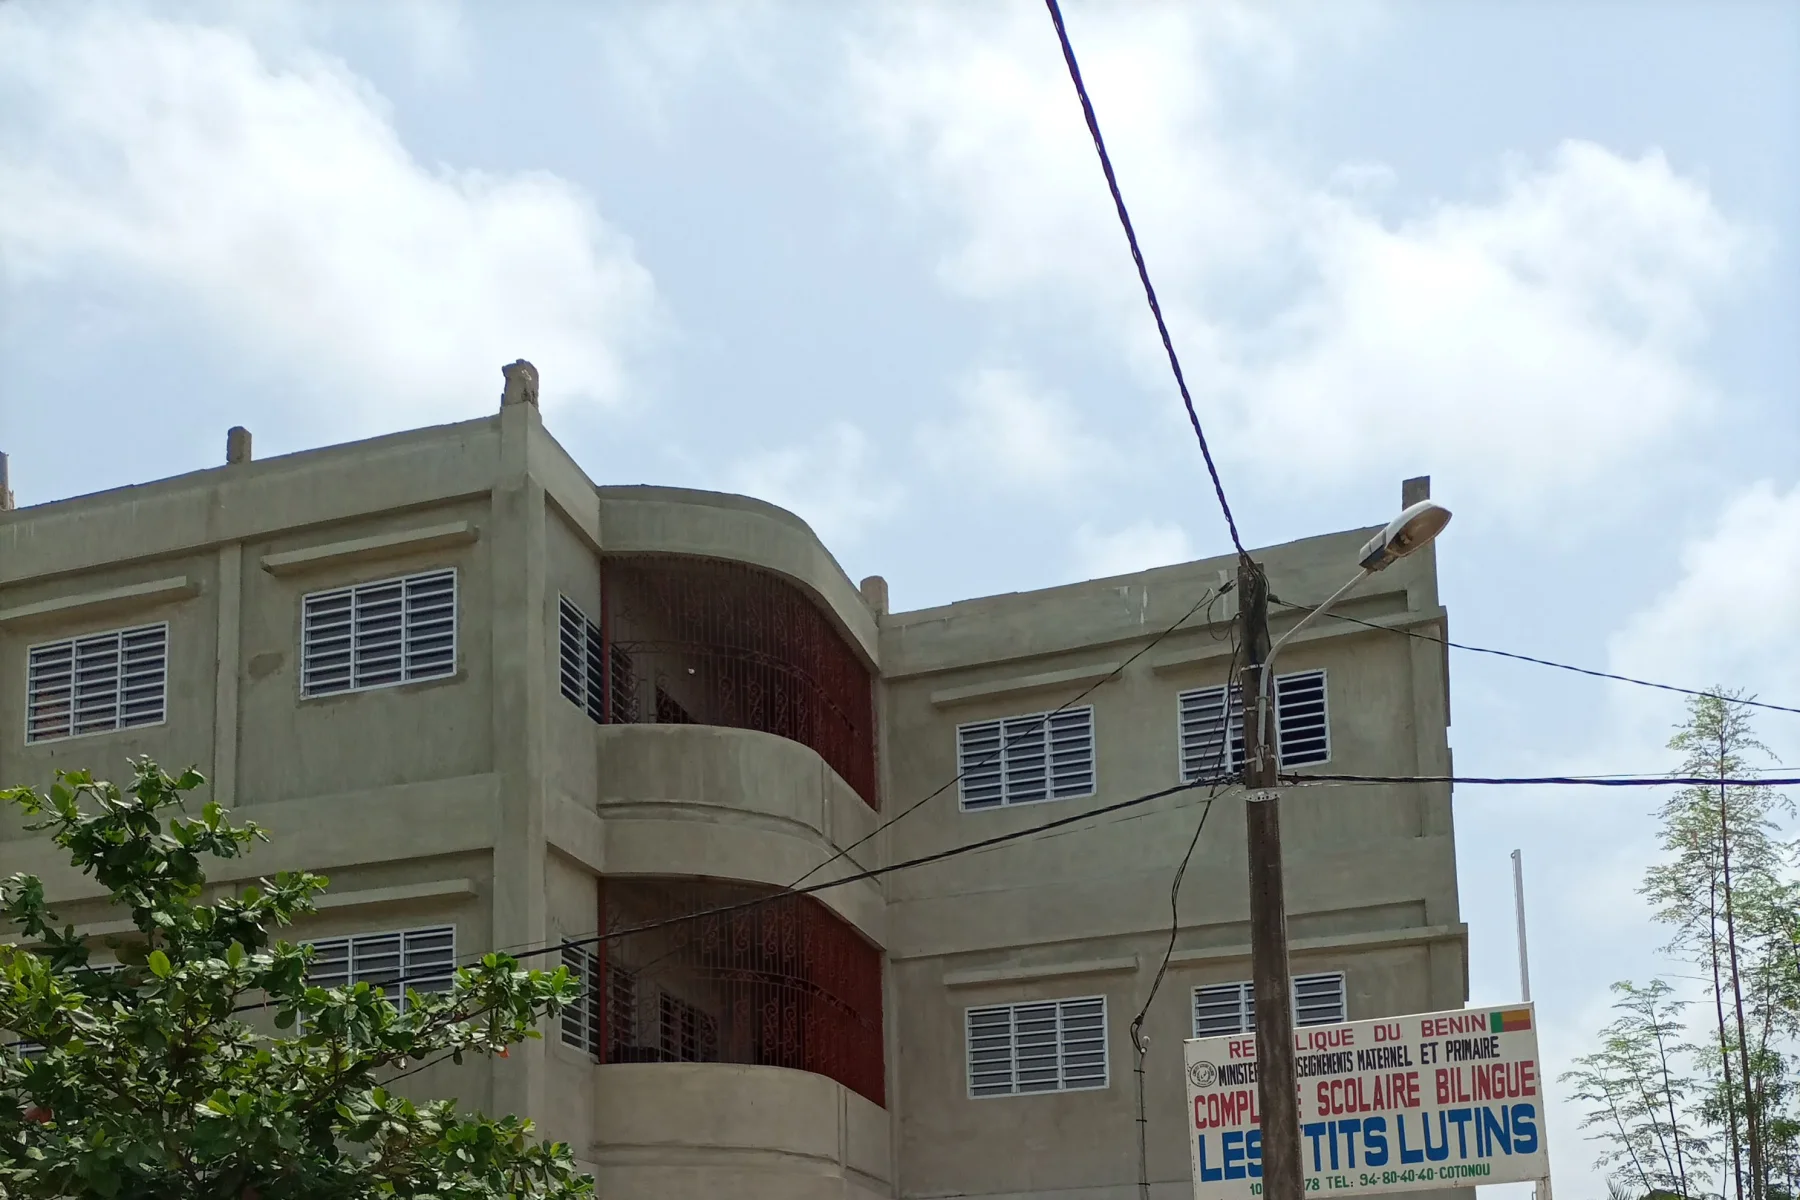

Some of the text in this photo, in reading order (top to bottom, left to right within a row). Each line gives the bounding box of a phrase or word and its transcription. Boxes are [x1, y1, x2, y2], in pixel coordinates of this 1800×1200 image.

[1229, 1013, 1486, 1058] RELIQUE DU BENIN
[1357, 1045, 1413, 1071] MATERNEL
[1420, 1041, 1439, 1065] ET
[1445, 1036, 1500, 1062] PRIMAIRE
[1194, 1060, 1536, 1129] COMPL SCOLAIRE BILINGUE
[1199, 1129, 1263, 1182] LES
[1397, 1103, 1538, 1165] LUTINS
